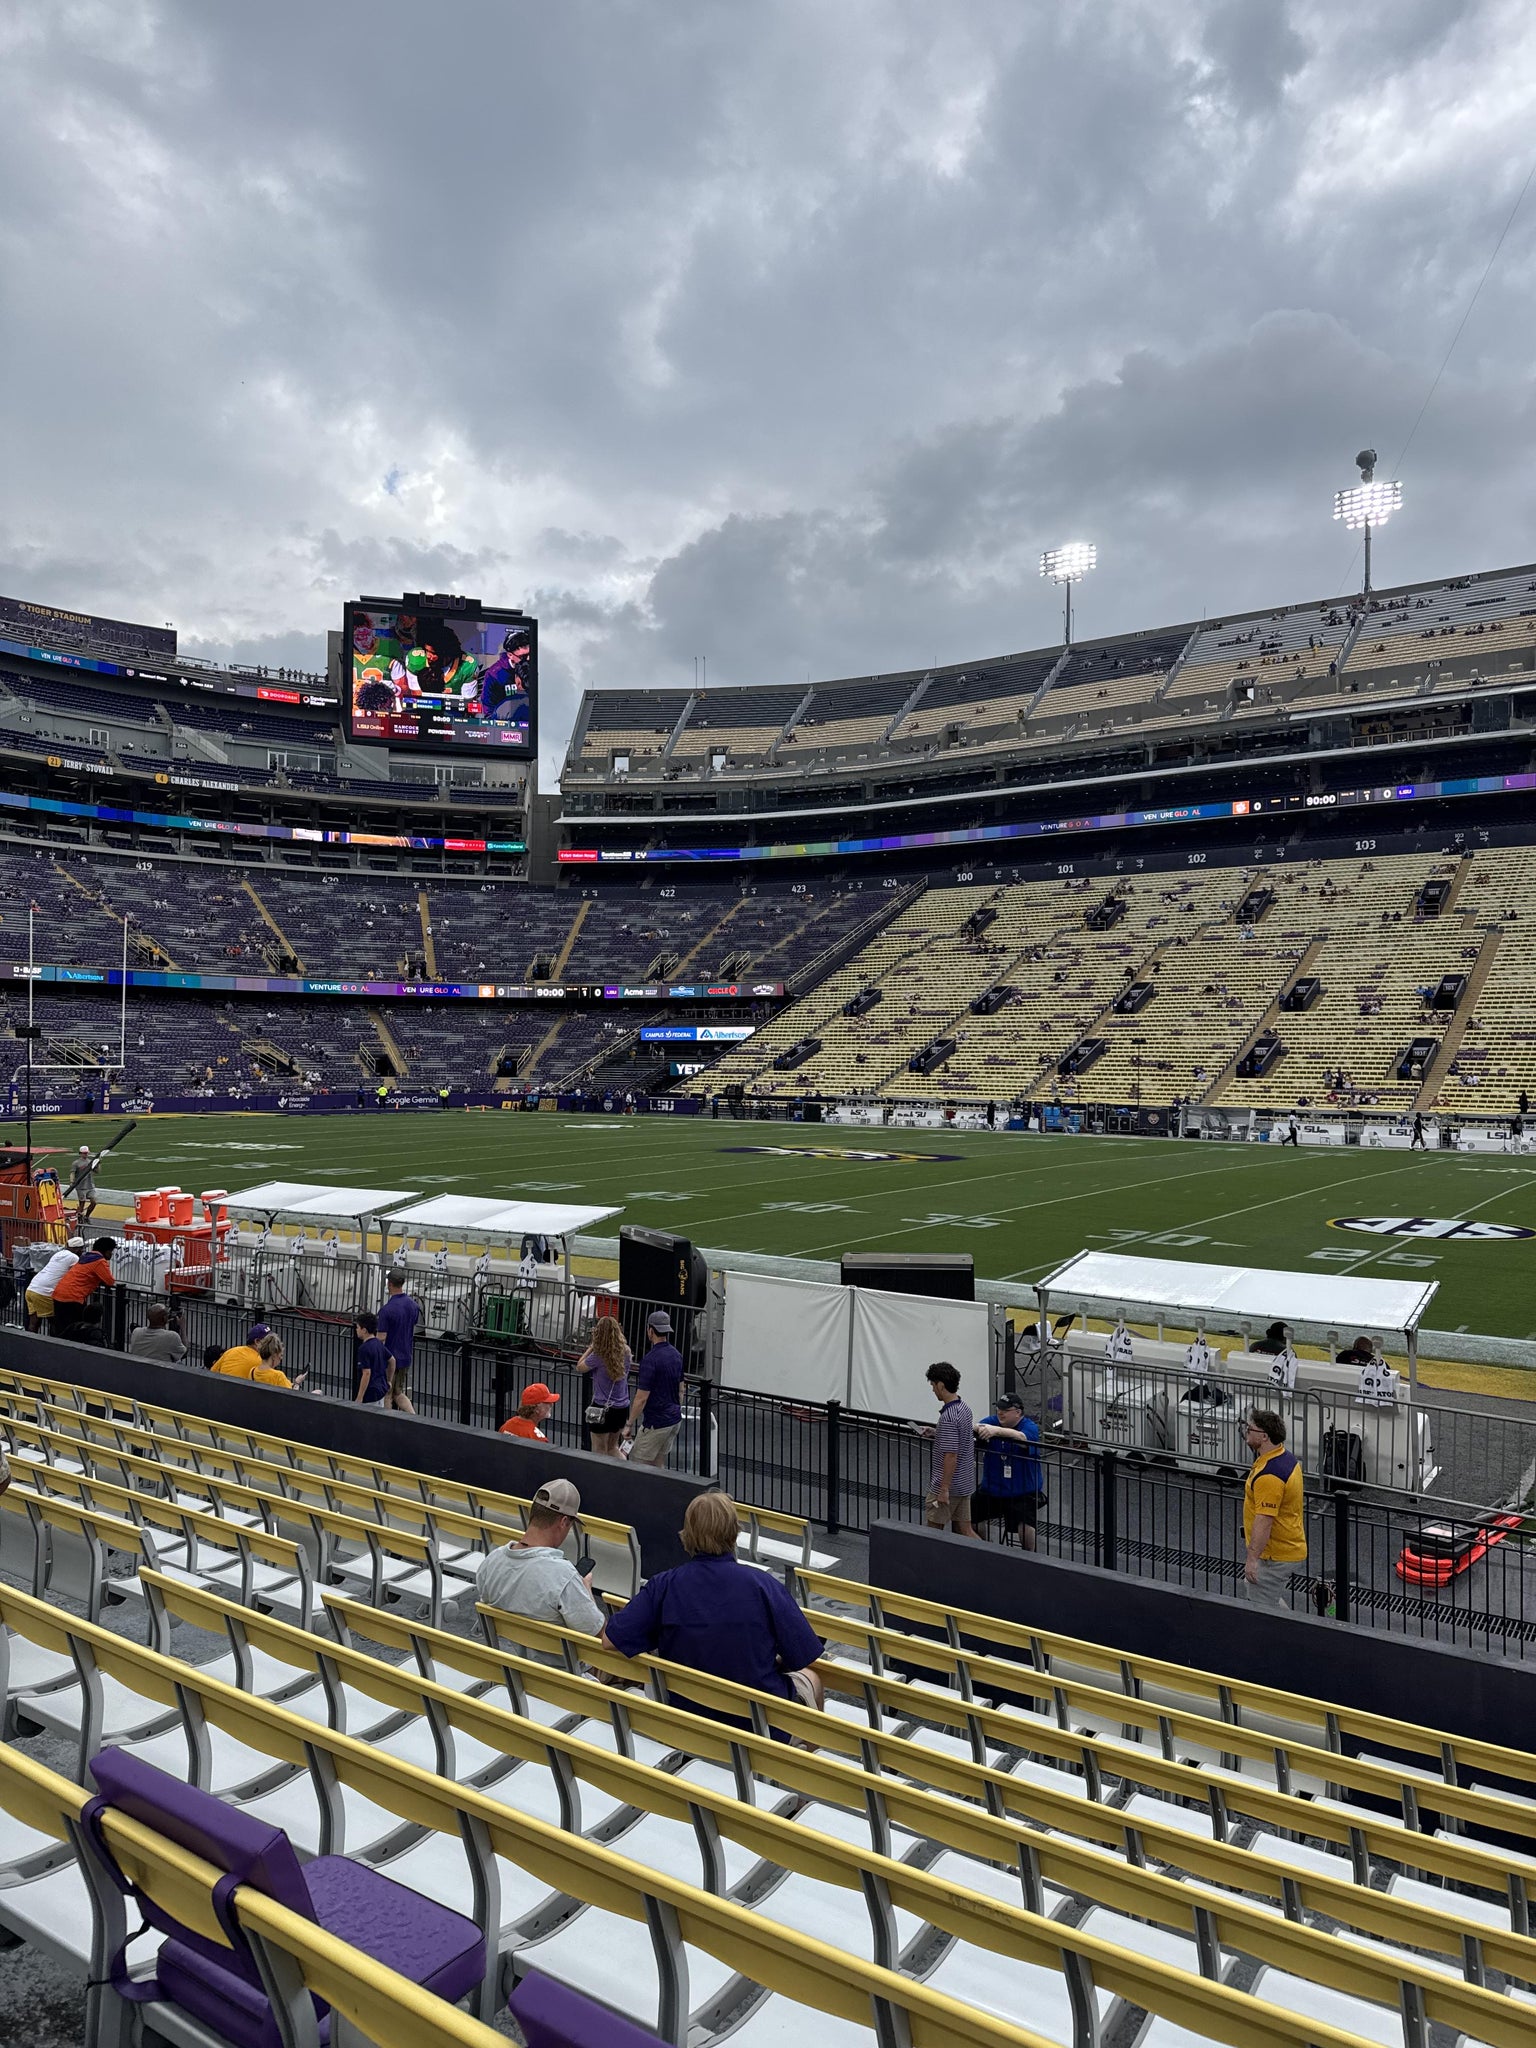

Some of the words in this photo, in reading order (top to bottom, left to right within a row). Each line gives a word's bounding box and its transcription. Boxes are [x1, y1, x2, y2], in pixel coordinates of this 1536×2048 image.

[419, 592, 466, 611] LSU
[26, 604, 52, 617] TIGER
[54, 609, 92, 625] STADIUM
[50, 758, 59, 766] 21
[63, 759, 83, 771] JERRY
[85, 763, 114, 775] STOVALL
[170, 776, 200, 787] CHARLES
[202, 780, 239, 792] ALEXANDER
[1306, 794, 1336, 806] 90:00
[1253, 802, 1262, 811] 0
[1143, 811, 1173, 820] VENURE
[1355, 839, 1377, 851] 103
[1187, 853, 1207, 864] 102
[136, 861, 153, 871] 419
[1057, 864, 1075, 874] 101
[322, 876, 339, 885] 420
[956, 872, 973, 882] 100
[882, 878, 898, 888] 424
[660, 889, 676, 897] 422
[791, 884, 807, 894] 423
[72, 973, 104, 981] Albertsons
[309, 983, 341, 991] VENTURE
[402, 986, 433, 994] VENURE
[624, 988, 644, 996] Acme
[707, 987, 729, 995] CIRCLE
[537, 988, 564, 997] 90:00
[121, 1099, 136, 1109] BLUE
[136, 1098, 155, 1108] PLATE
[385, 1096, 411, 1105] Google
[412, 1096, 439, 1104] Gemini
[649, 1099, 674, 1111] LSU
[1486, 1131, 1512, 1140] LSU
[168, 1202, 176, 1213] G
[1304, 1247, 1444, 1268] 25
